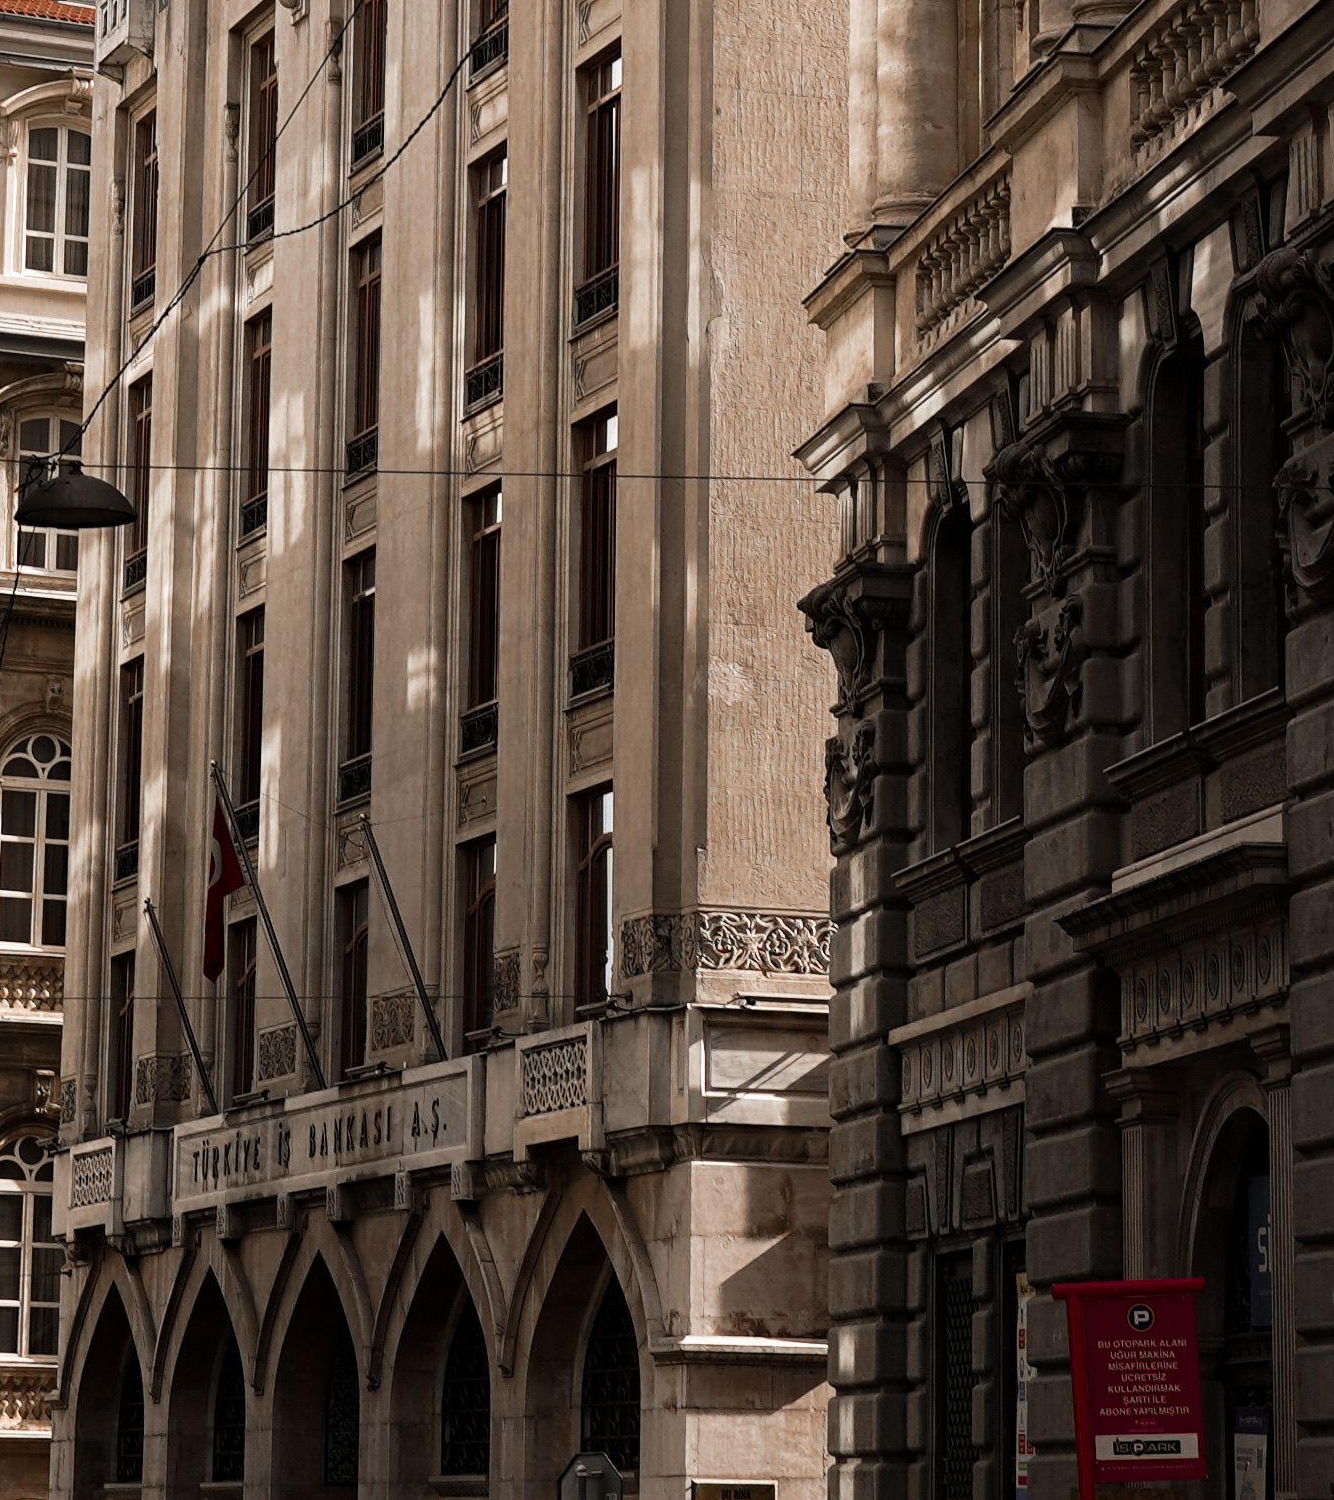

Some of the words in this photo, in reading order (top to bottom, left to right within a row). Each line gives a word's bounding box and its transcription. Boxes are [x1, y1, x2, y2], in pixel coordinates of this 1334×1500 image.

[193, 1132, 260, 1182] TÜRKİYE
[278, 1123, 290, 1168] İŞ
[309, 1106, 392, 1158] BANKASI
[411, 1098, 447, 1140] A.Ş.
[1098, 1340, 1111, 1349] BU
[1113, 1339, 1156, 1349] OTOPARK
[1159, 1338, 1187, 1348] ALANI
[1108, 1384, 1181, 1393] KULLANDIRMAK
[1153, 1393, 1167, 1405] İLE
[1099, 1406, 1131, 1417] ABONE
